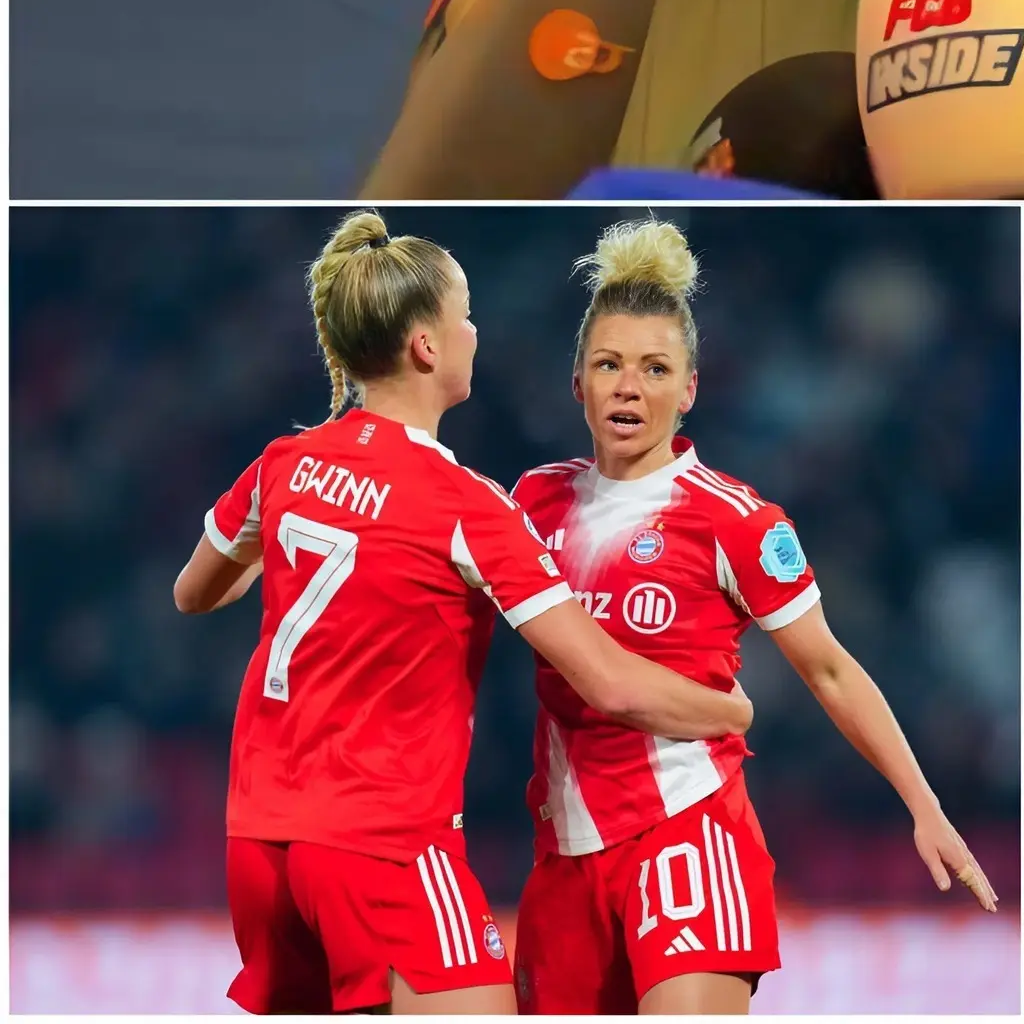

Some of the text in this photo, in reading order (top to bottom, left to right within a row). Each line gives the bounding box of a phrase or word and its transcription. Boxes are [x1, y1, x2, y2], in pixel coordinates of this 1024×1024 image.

[289, 456, 392, 520] GWINN
[263, 511, 359, 703] 7
[637, 842, 706, 941] 10
